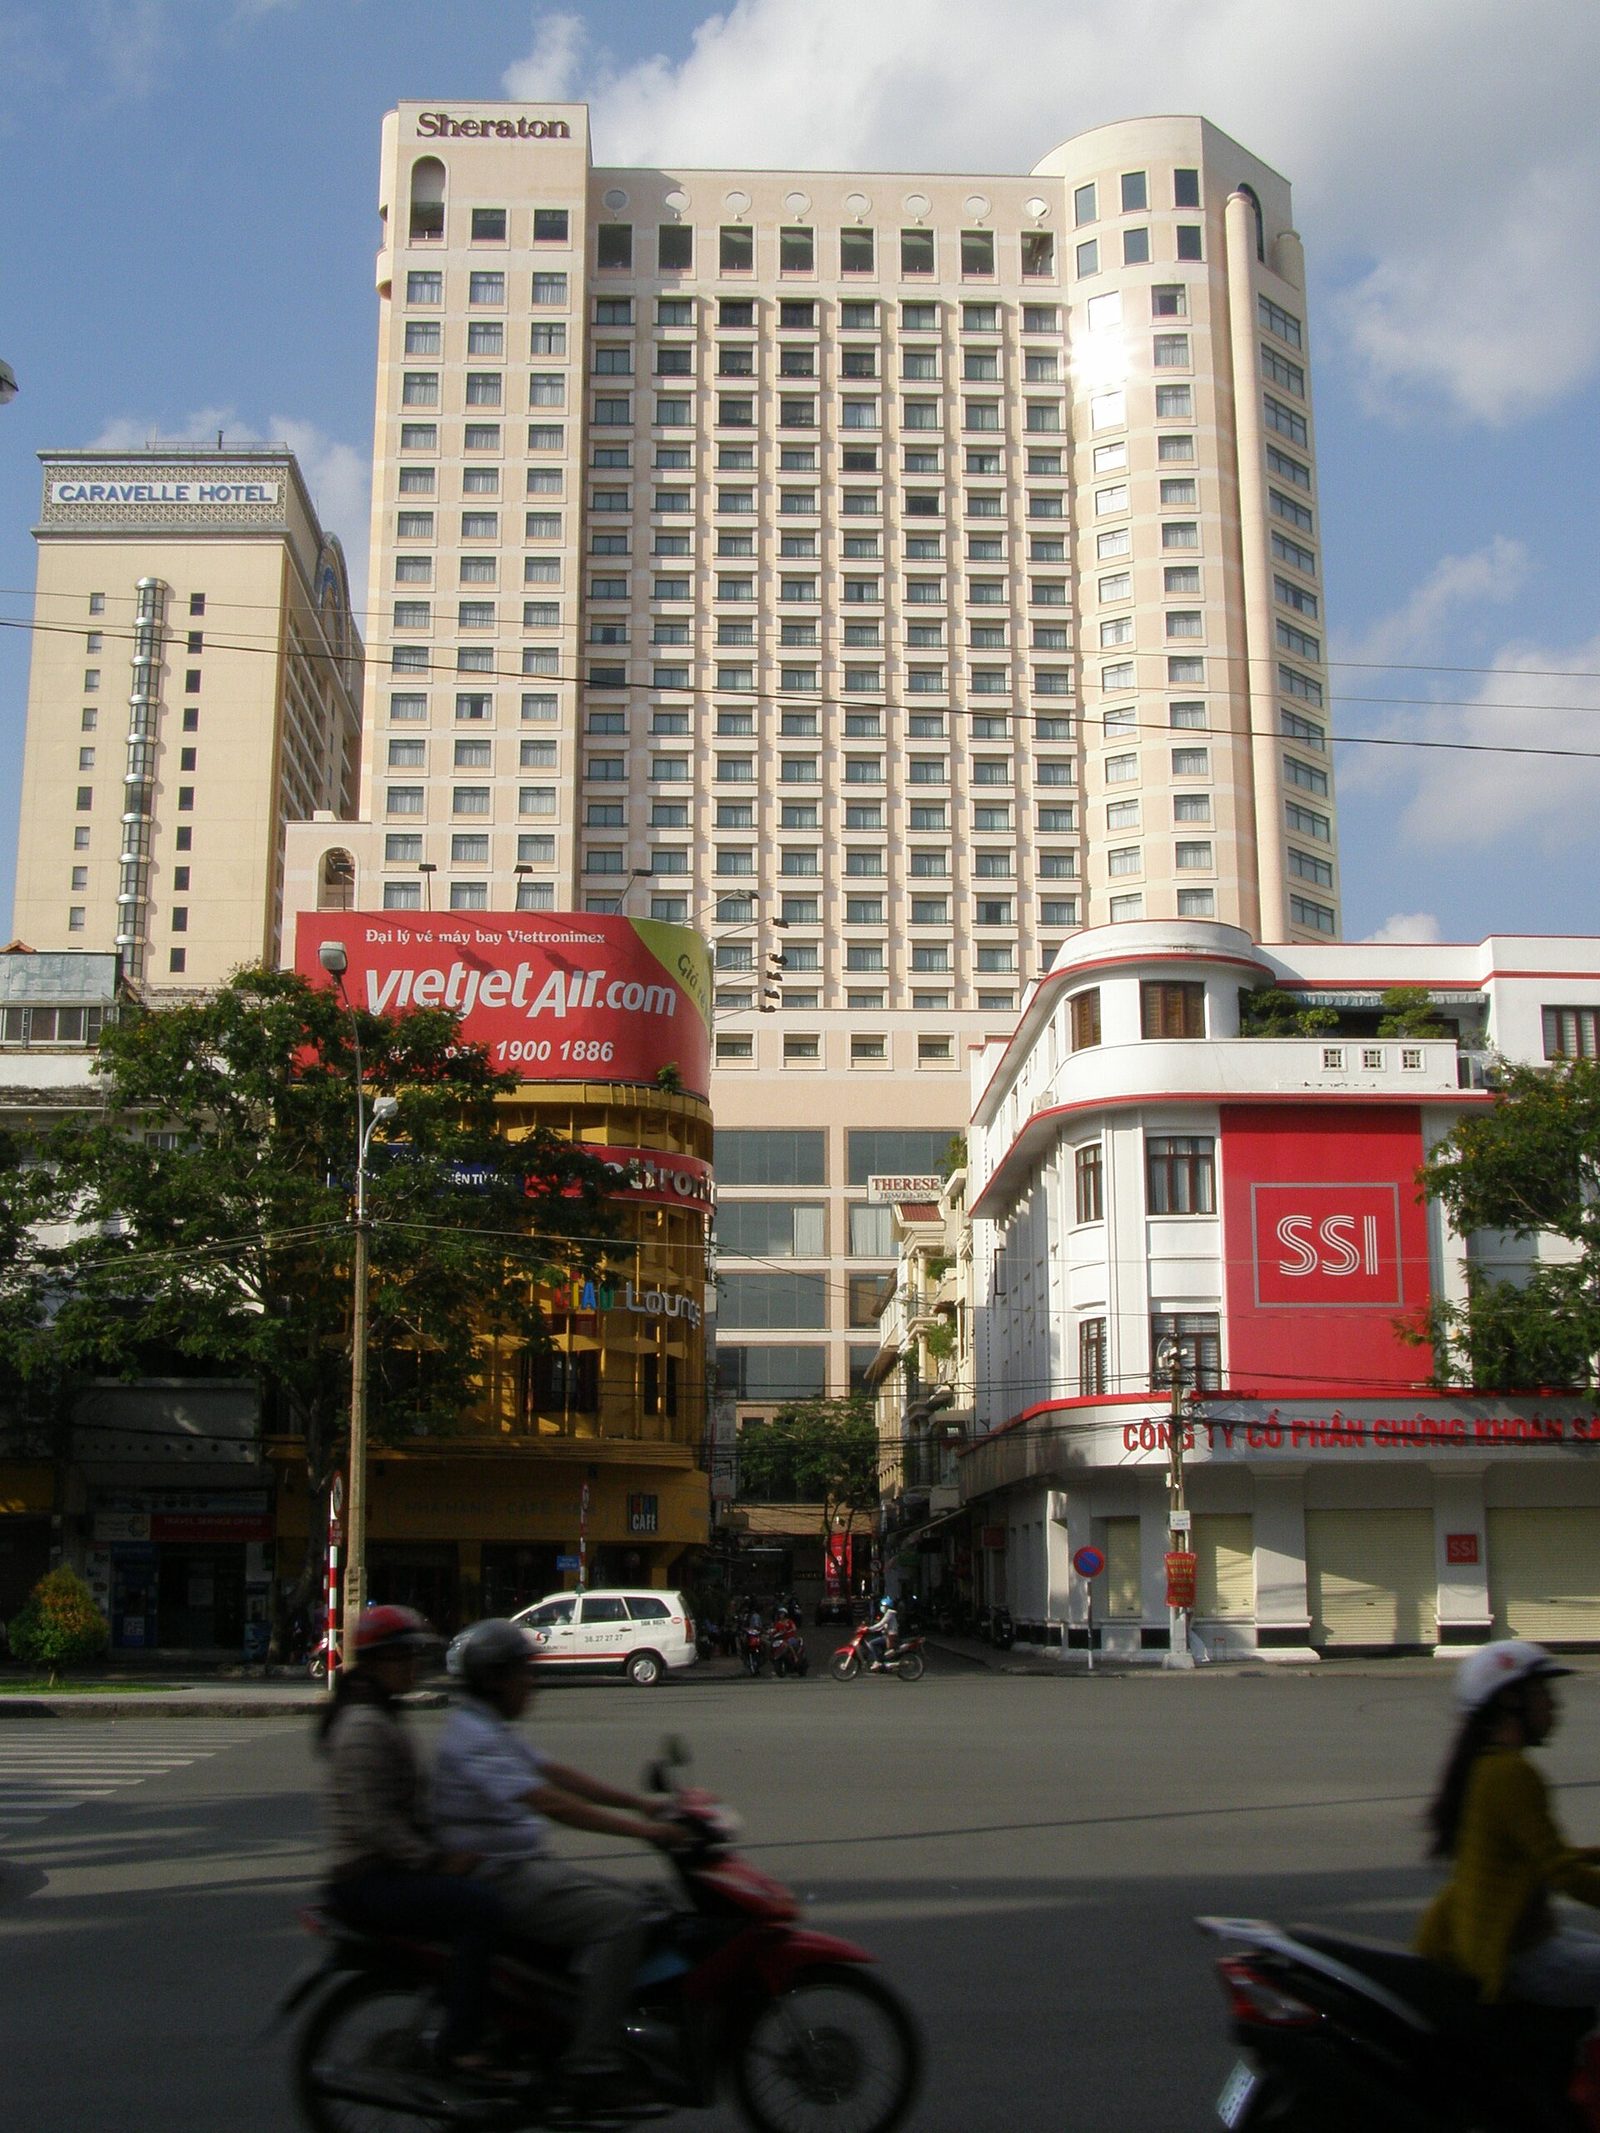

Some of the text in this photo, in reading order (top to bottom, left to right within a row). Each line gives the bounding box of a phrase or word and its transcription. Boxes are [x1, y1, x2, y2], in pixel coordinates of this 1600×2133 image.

[416, 112, 571, 139] Sheraton
[58, 485, 273, 502] CARAVELLE HOTEL
[439, 930, 470, 945] máy
[476, 930, 503, 945] bay
[506, 930, 606, 944] Viettronimex
[497, 1040, 551, 1062] 1900
[559, 1040, 614, 1063] 1886
[872, 1177, 939, 1191] THERESE
[1276, 1214, 1379, 1276] SSI
[1123, 1418, 1195, 1451] CÔNG
[1202, 1420, 1235, 1449] TY
[1450, 1540, 1475, 1557] SSI
